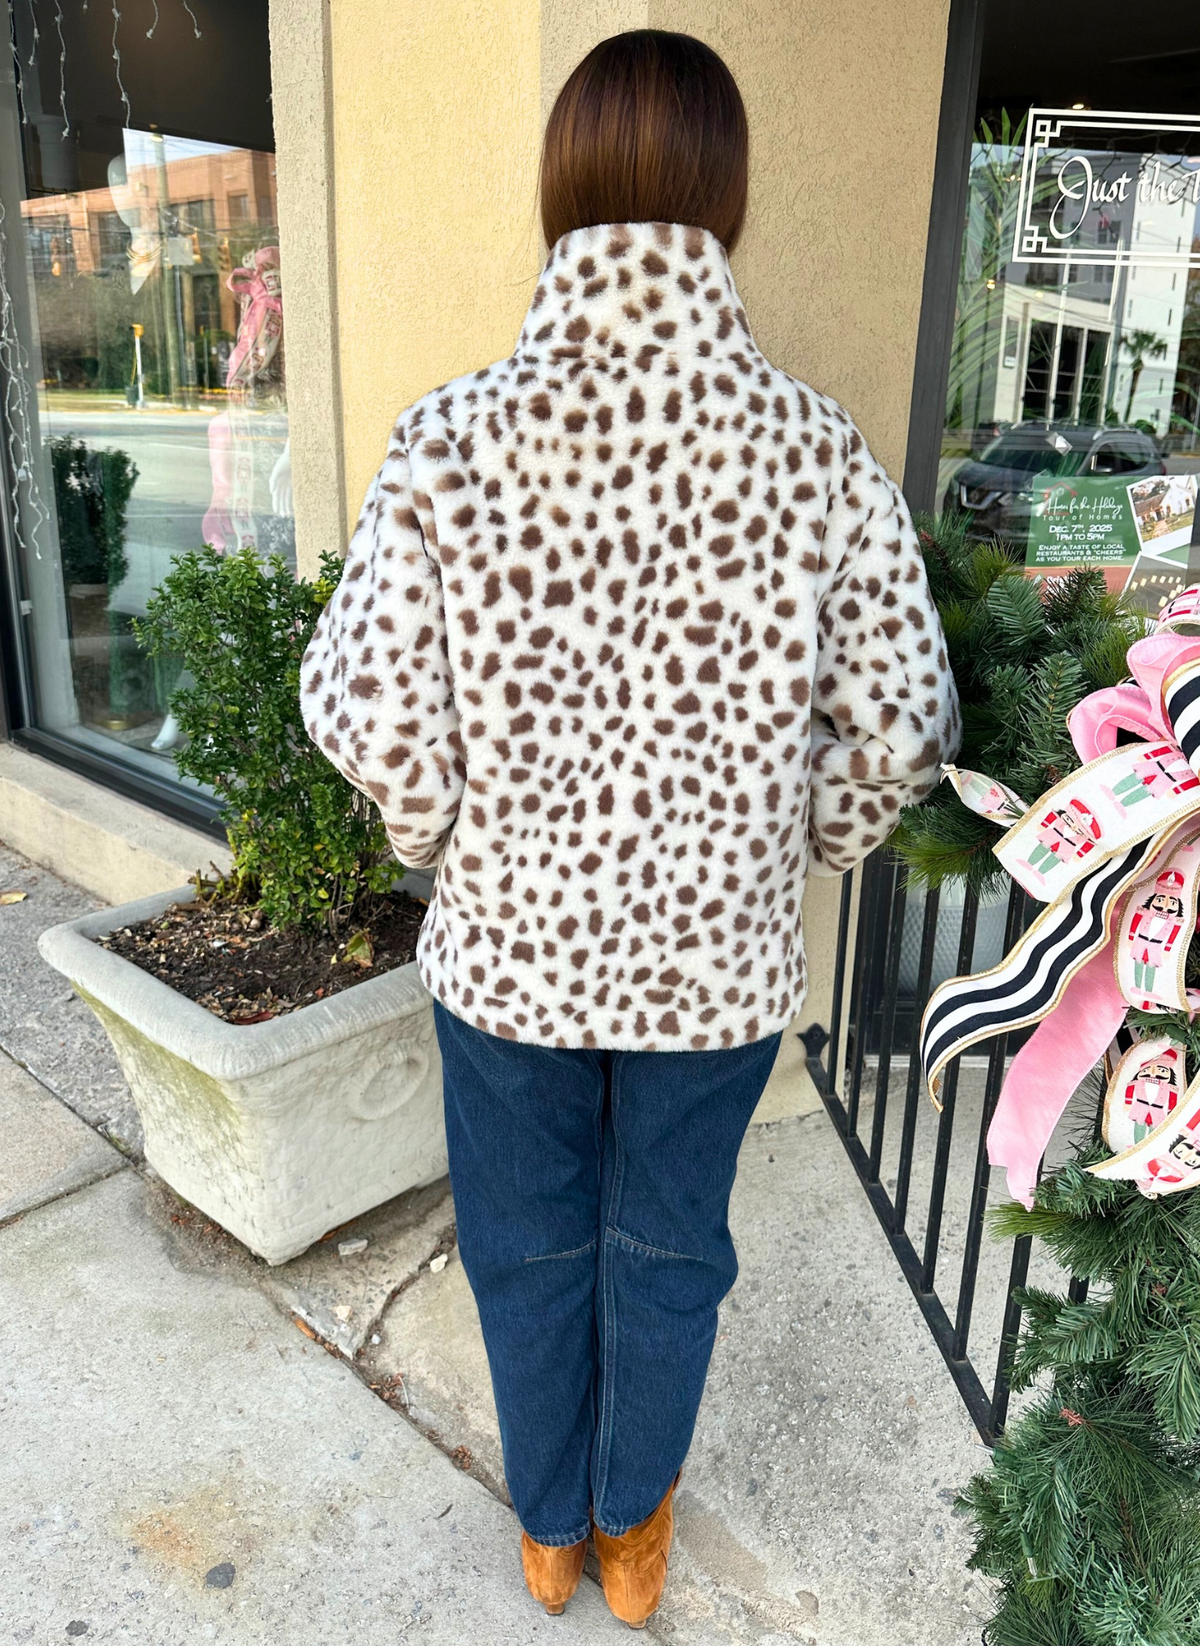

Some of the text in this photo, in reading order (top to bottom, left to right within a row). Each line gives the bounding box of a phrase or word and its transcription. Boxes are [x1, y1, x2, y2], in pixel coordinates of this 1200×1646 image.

[1050, 156, 1133, 240] Just
[1138, 161, 1183, 203] the
[1089, 524, 1113, 532] 2025
[1087, 532, 1105, 540] 5PM
